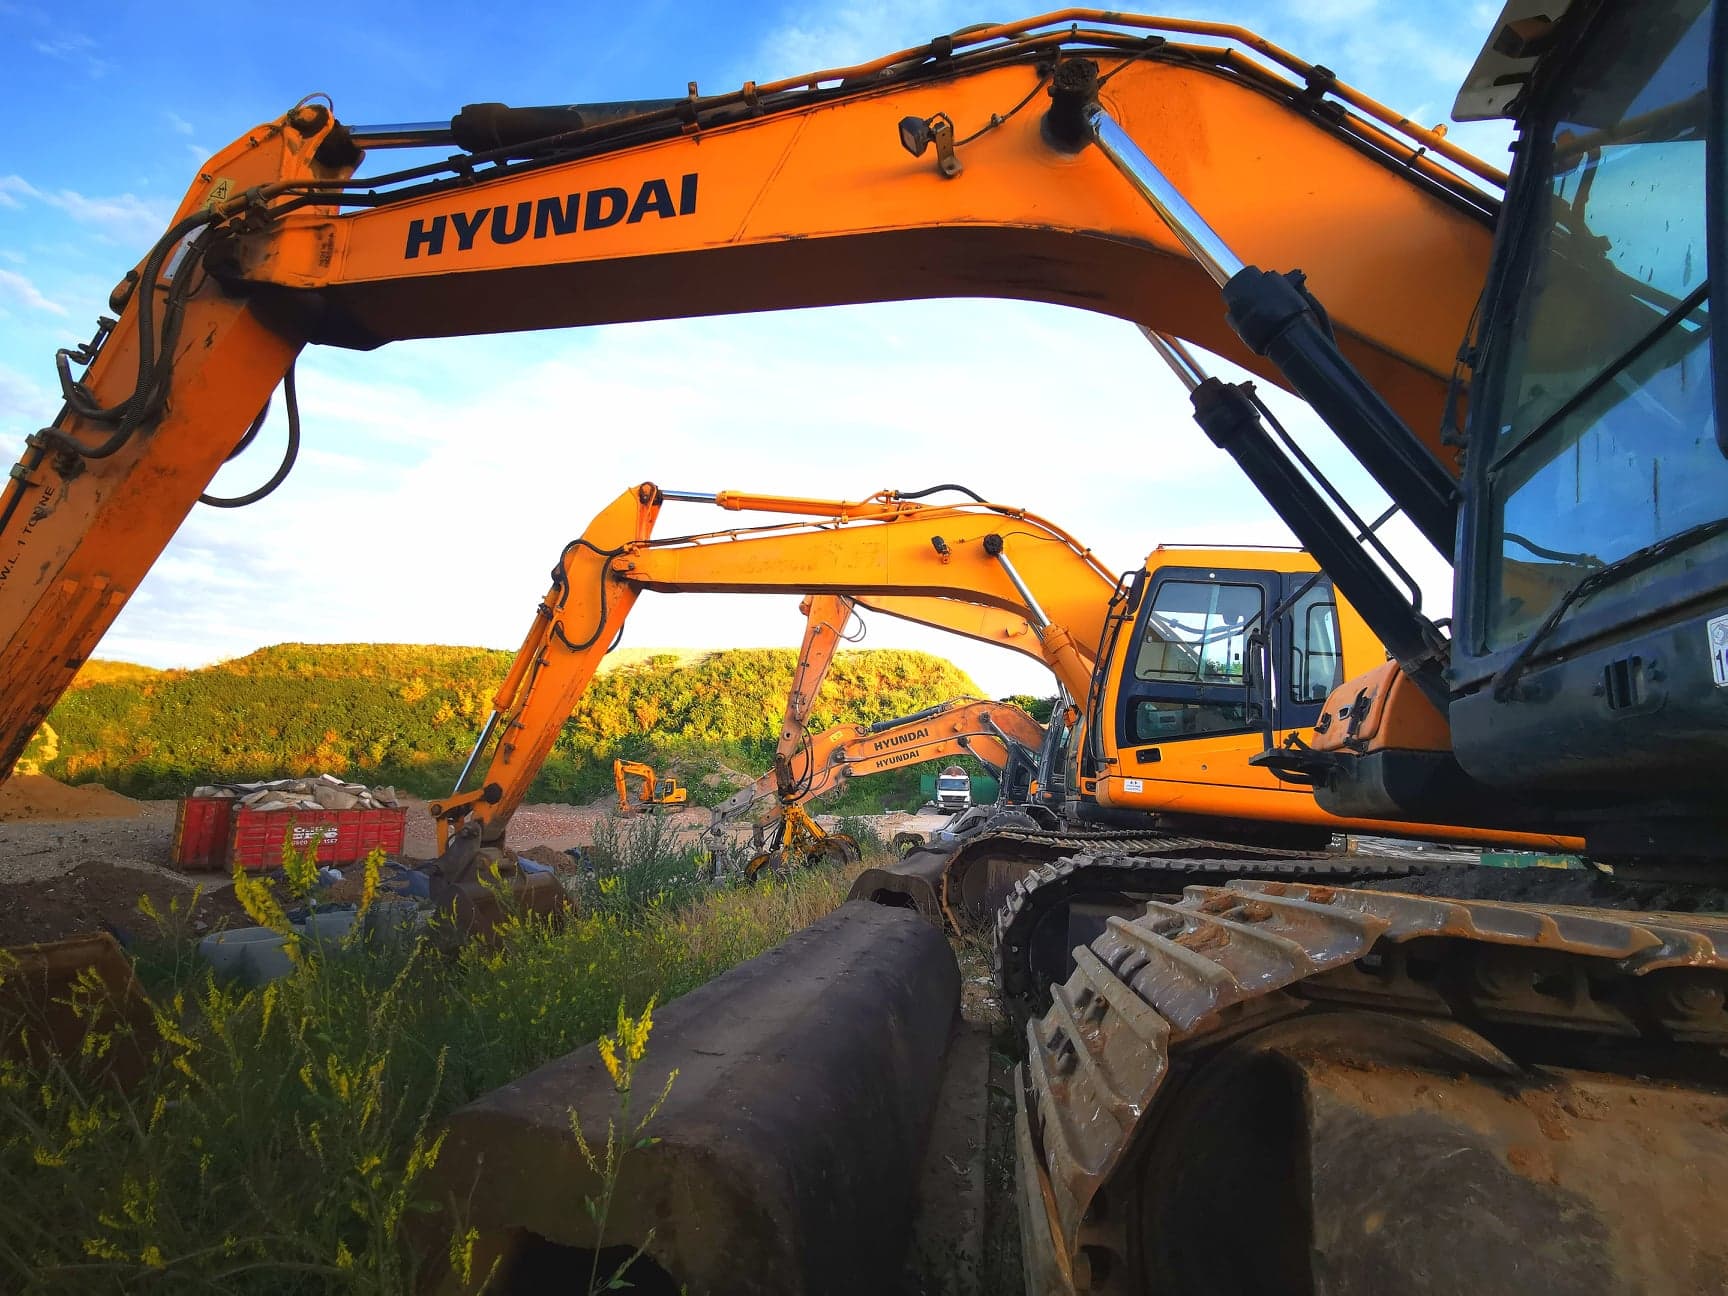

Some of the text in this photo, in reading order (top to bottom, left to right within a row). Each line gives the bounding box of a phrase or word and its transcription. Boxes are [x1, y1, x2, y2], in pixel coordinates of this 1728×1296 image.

[405, 173, 698, 259] HYUNDAI
[873, 728, 929, 751] HYUNDAI
[876, 750, 920, 768] HYUNDAI
